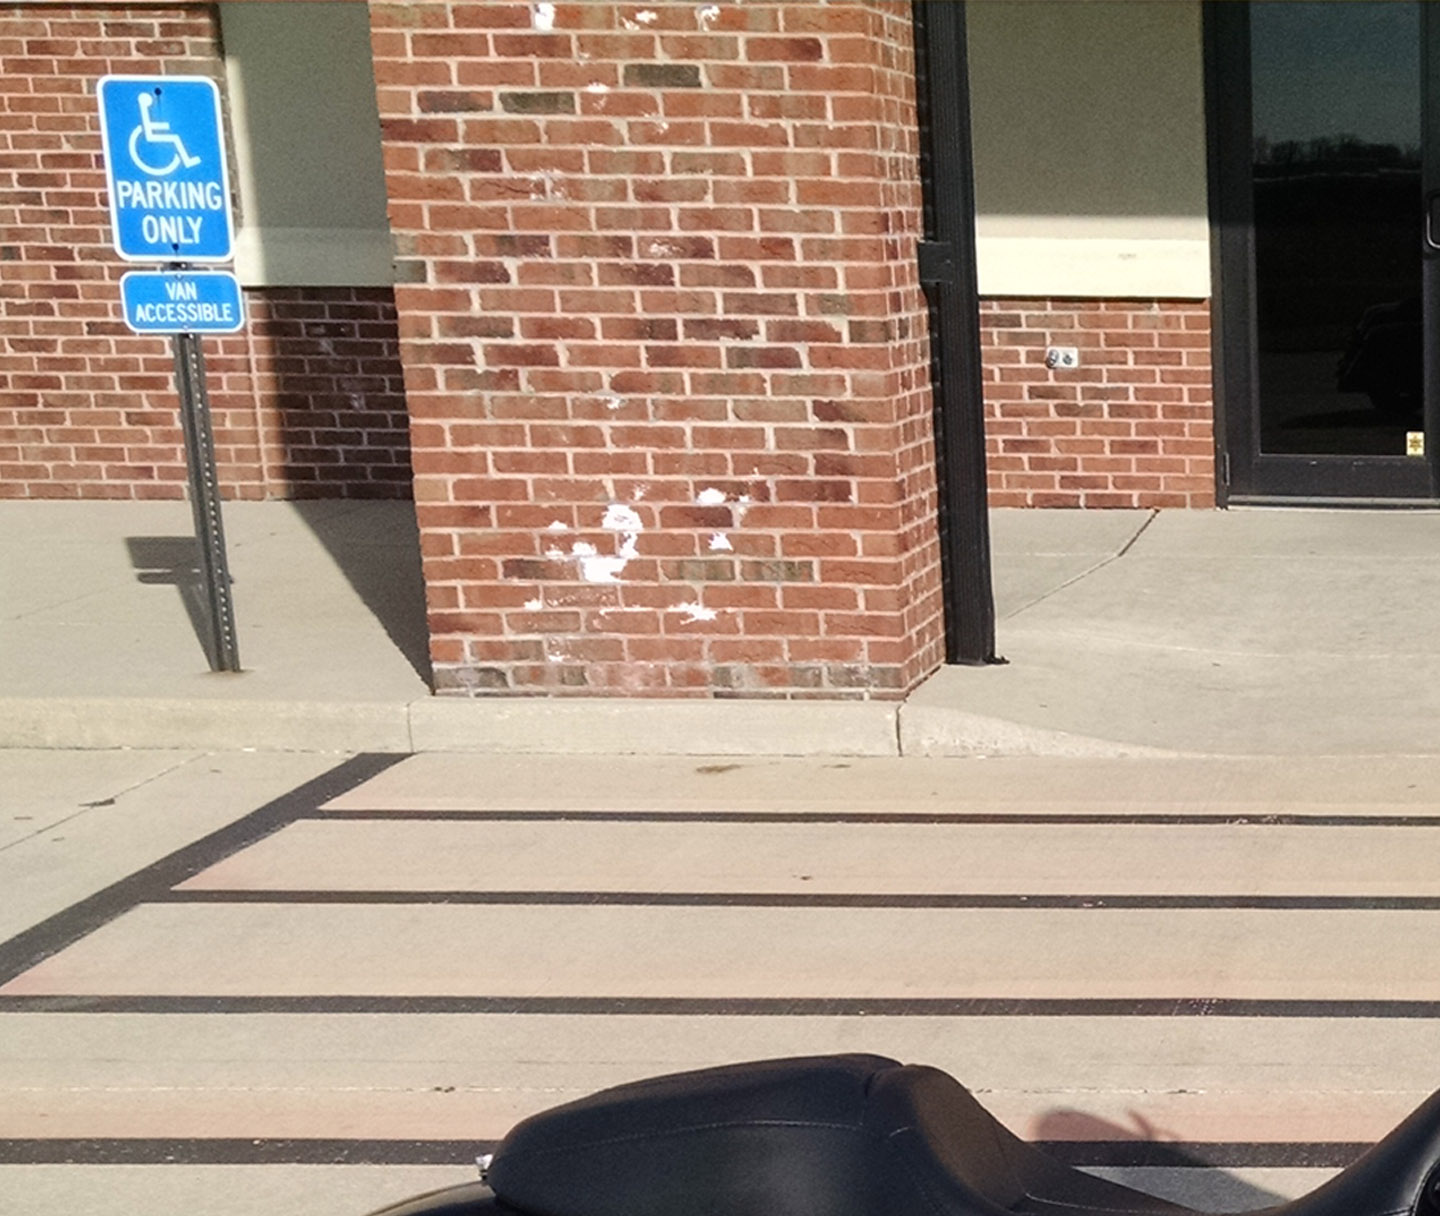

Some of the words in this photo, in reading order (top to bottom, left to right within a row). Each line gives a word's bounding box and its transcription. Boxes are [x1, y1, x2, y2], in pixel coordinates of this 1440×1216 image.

[116, 180, 223, 211] PARKING
[141, 214, 203, 244] ONLY
[165, 281, 198, 300] VAN
[134, 303, 234, 323] ACCESSIBLE
